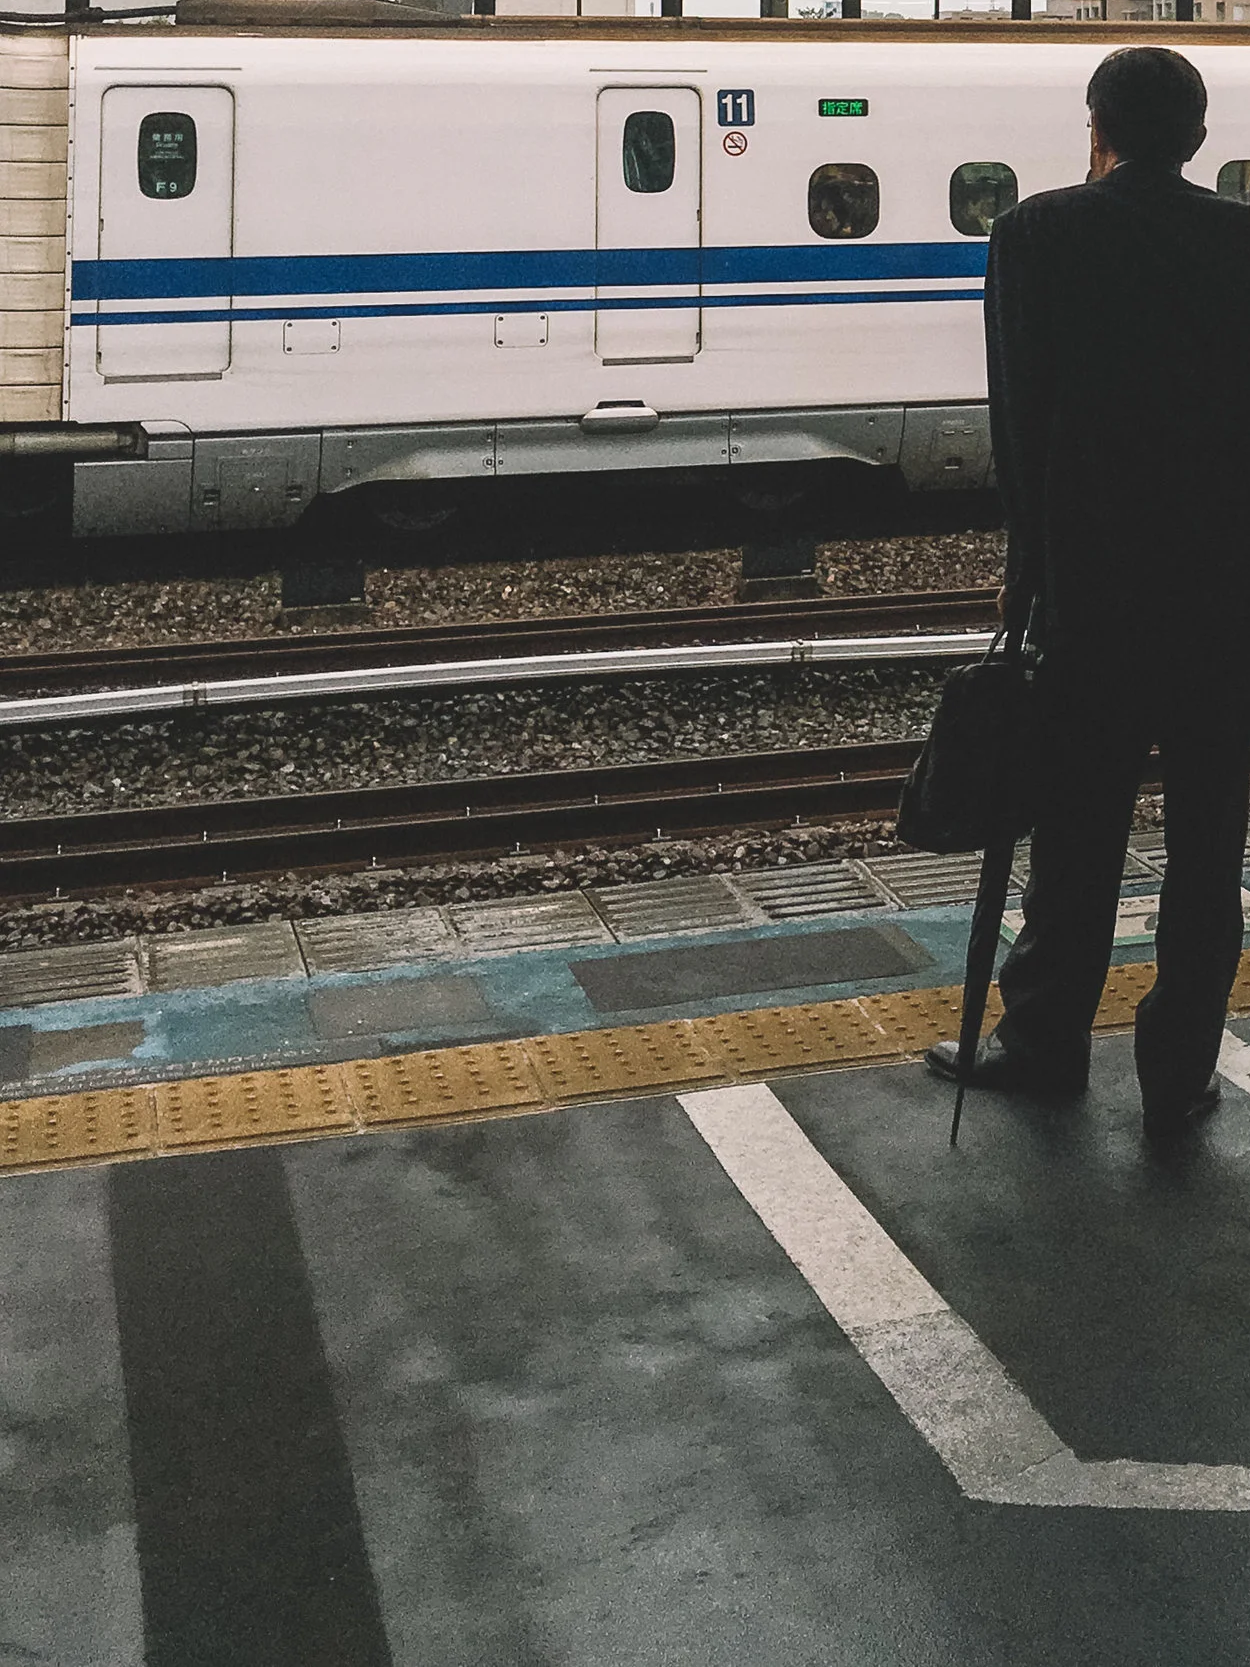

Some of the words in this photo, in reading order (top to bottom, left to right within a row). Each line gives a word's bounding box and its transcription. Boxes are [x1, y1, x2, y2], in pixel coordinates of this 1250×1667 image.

[721, 93, 748, 123] 11
[822, 101, 862, 115] 指定席
